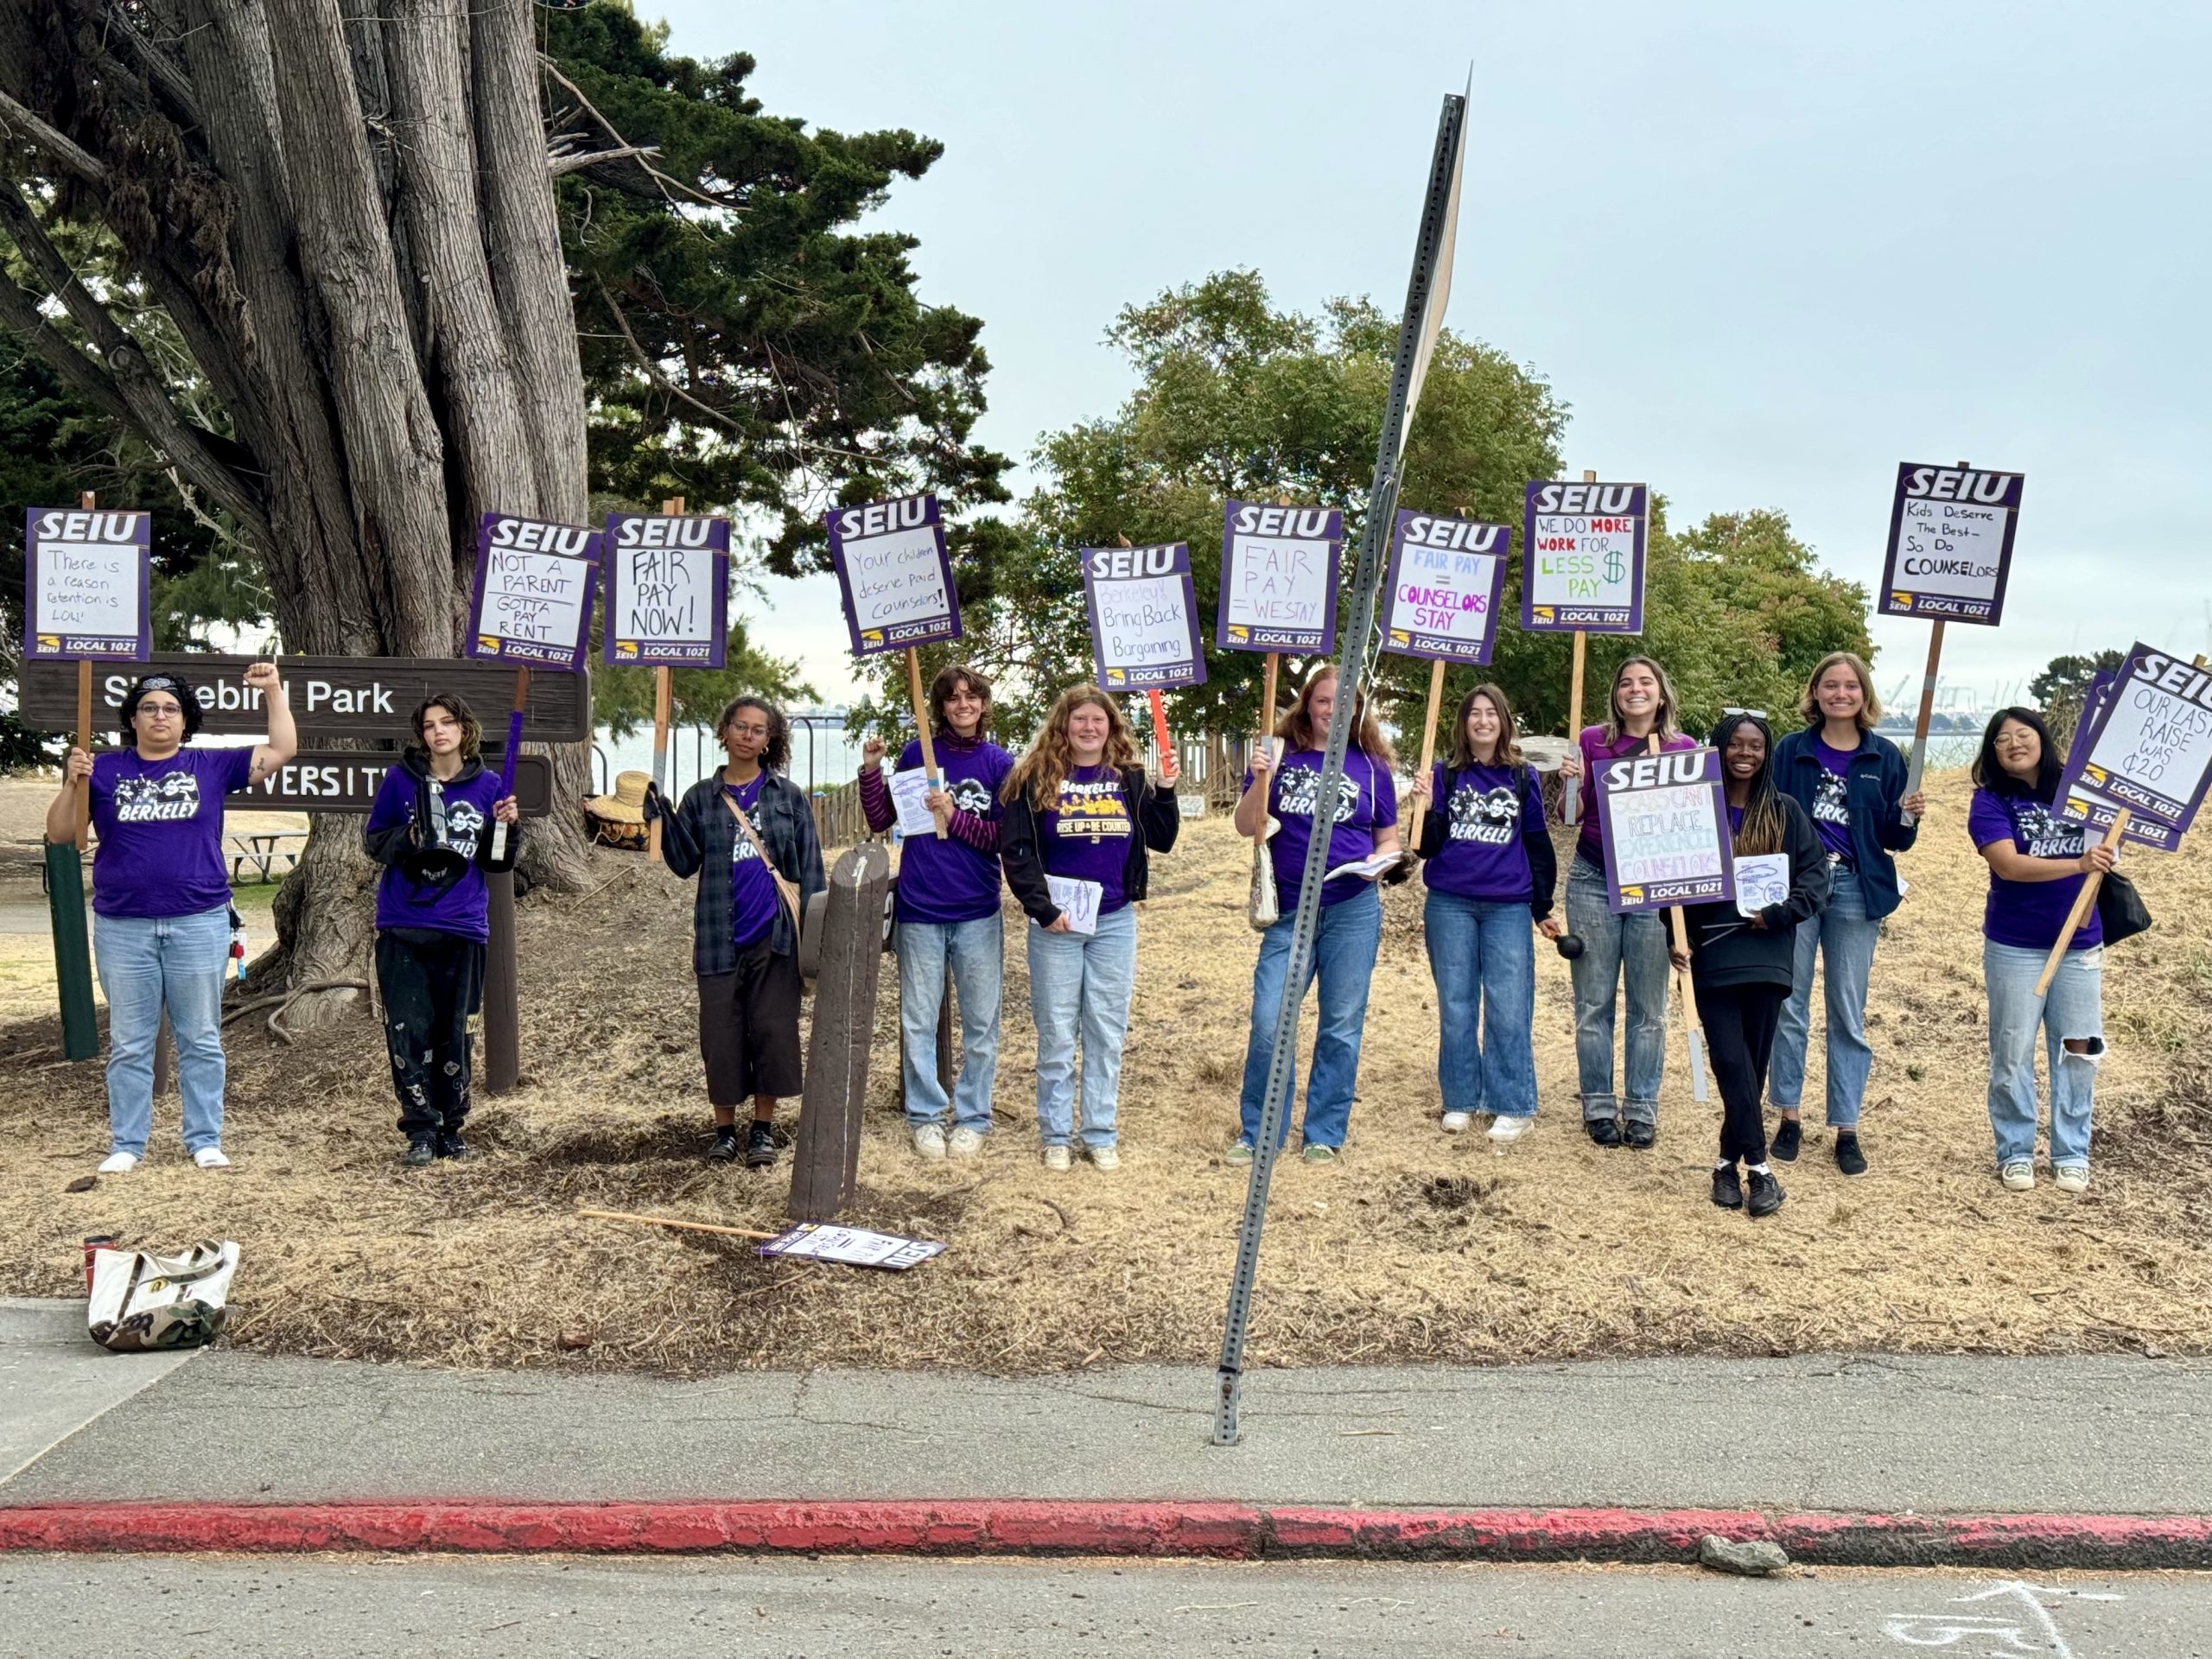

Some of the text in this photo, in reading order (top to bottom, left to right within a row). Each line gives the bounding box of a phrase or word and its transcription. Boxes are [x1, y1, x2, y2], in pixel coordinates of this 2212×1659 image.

[1907, 467, 2012, 503] SEIU
[1536, 485, 1633, 514] SEIU
[1907, 501, 1933, 517] Kids
[38, 512, 137, 542] SEIU
[841, 496, 925, 540] SEIU
[1235, 505, 1330, 537] SEIU
[1538, 518, 1632, 534] WE DO MORE
[1916, 523, 1936, 533] The
[492, 518, 590, 556] SEIU
[618, 518, 711, 547] SEIU
[1405, 516, 1499, 551] SEIU
[1537, 537, 1610, 553] WORK FOR
[1906, 536, 1953, 552] So Do
[47, 550, 119, 573] There is
[492, 551, 563, 575] NOT A
[632, 550, 690, 585] FAIR
[853, 551, 892, 575] Your
[1092, 545, 1175, 579] SEIU
[1245, 545, 1313, 575] FAIR
[1414, 550, 1482, 575] FAIR PAY
[1541, 550, 1626, 584] LESS $
[1904, 557, 1999, 577] COUNSELORS
[48, 575, 110, 590] a reason
[504, 575, 572, 594] PARENT
[859, 578, 904, 600] deserve
[1245, 571, 1296, 597] PAY
[1435, 575, 1451, 585] =
[1568, 578, 1602, 599] PAY
[47, 592, 119, 607] retention is
[497, 596, 550, 613] GOTTA
[638, 583, 677, 607] PAY
[1398, 583, 1487, 613] COUNSELORS
[513, 611, 537, 623] PAY
[1560, 611, 1630, 622] LOCAL 1021
[1917, 600, 1960, 613] LOCAL
[1963, 605, 1990, 615] 1021
[1413, 607, 1456, 631] STAY
[499, 621, 552, 640] RENT
[889, 626, 927, 641] LOCAL
[929, 620, 951, 632] 1021
[1254, 632, 1322, 645] LOCAL 1021
[66, 640, 137, 652] LOCAL 1021
[505, 645, 544, 658] LOCAL
[548, 650, 574, 662] 1021
[644, 647, 709, 657] LOCAL 1021
[1112, 635, 1180, 663] Bargaining
[1414, 638, 1452, 652] LOCAL
[1455, 645, 1481, 656] 1021
[1130, 670, 1166, 682] LOCAL
[1168, 666, 1193, 678] 1021
[308, 682, 394, 714] Park
[2134, 689, 2171, 719] OUR
[2139, 717, 2193, 752] RAISE
[2140, 740, 2173, 765] WAS
[1608, 752, 1706, 791] SEIU
[1060, 780, 1119, 794] BERKELEY
[2109, 781, 2151, 805] LOCAL
[2152, 801, 2183, 818] 1021
[118, 803, 199, 821] BERKELEY
[1075, 822, 1084, 832] UP
[1091, 822, 1101, 832] BE
[1628, 810, 1702, 836] REPLACE
[2139, 822, 2169, 840] 1021
[2029, 836, 2083, 856] BERKEL
[1650, 885, 1692, 898] LOCAL
[1695, 882, 1723, 893] 1021
